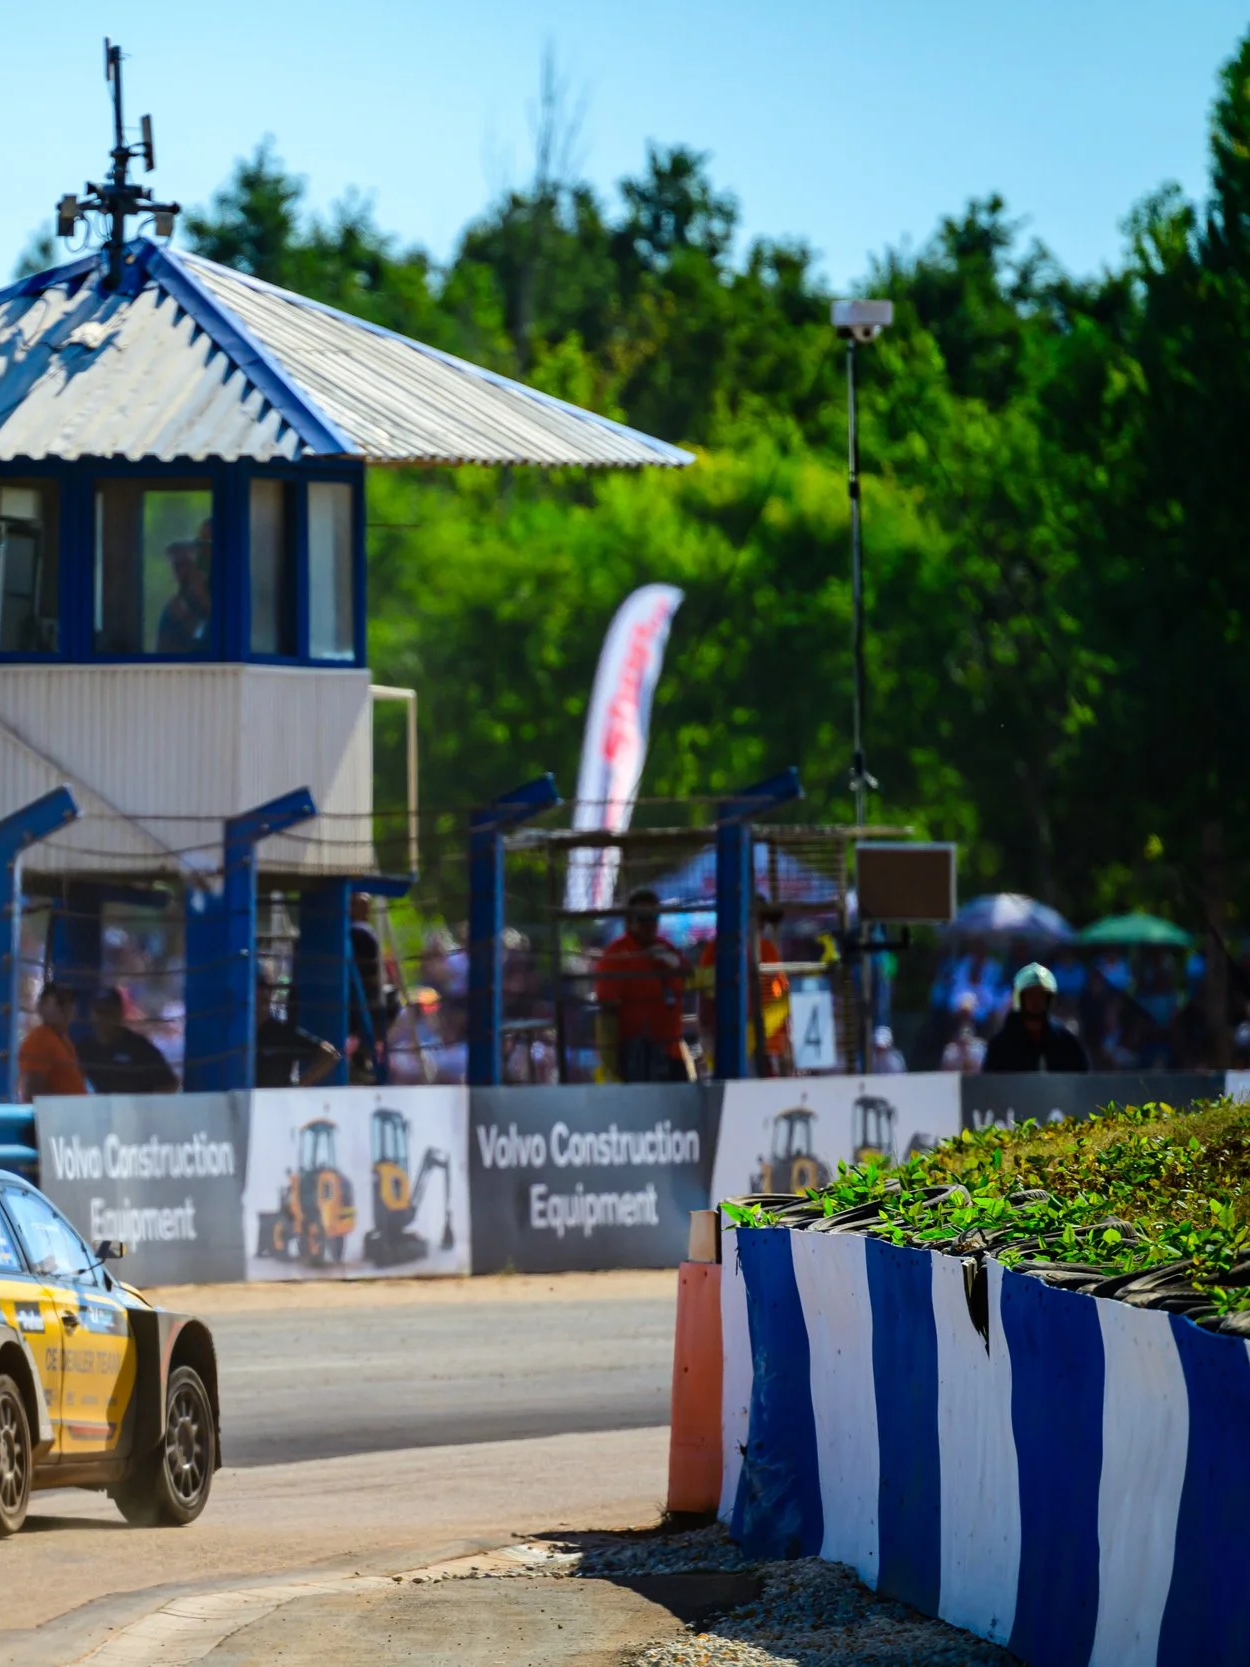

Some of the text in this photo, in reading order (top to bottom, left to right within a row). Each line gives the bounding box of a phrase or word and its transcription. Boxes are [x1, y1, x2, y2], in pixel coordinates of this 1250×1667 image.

[803, 1004, 823, 1060] 4
[50, 1131, 235, 1180] Volvo Construction
[477, 1119, 700, 1169] Volvo Construction
[90, 1197, 198, 1252] Equipment
[529, 1182, 660, 1239] Equipment
